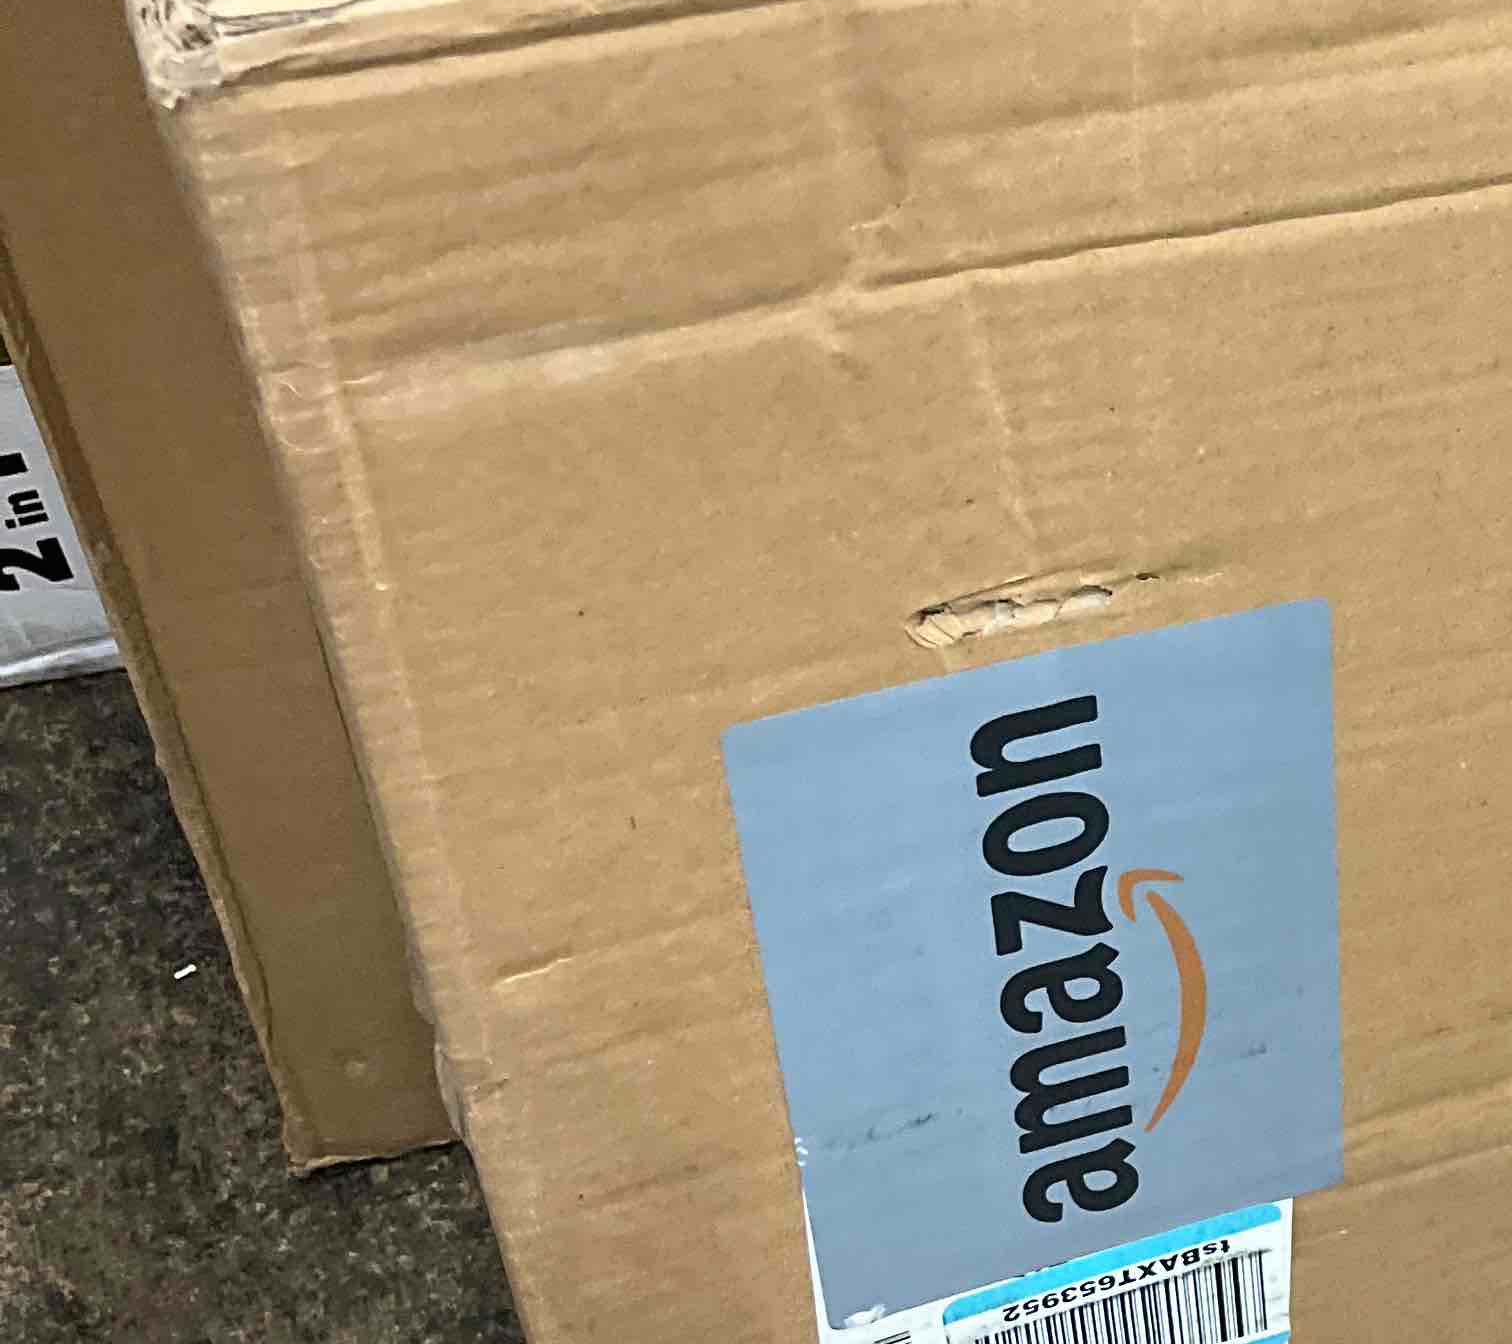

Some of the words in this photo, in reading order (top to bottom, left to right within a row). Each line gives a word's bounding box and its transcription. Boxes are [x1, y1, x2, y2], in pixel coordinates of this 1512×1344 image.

[5, 489, 49, 529] in
[969, 694, 1140, 1224] amazon
[1002, 1239, 1230, 1322] tsBAXT653952
